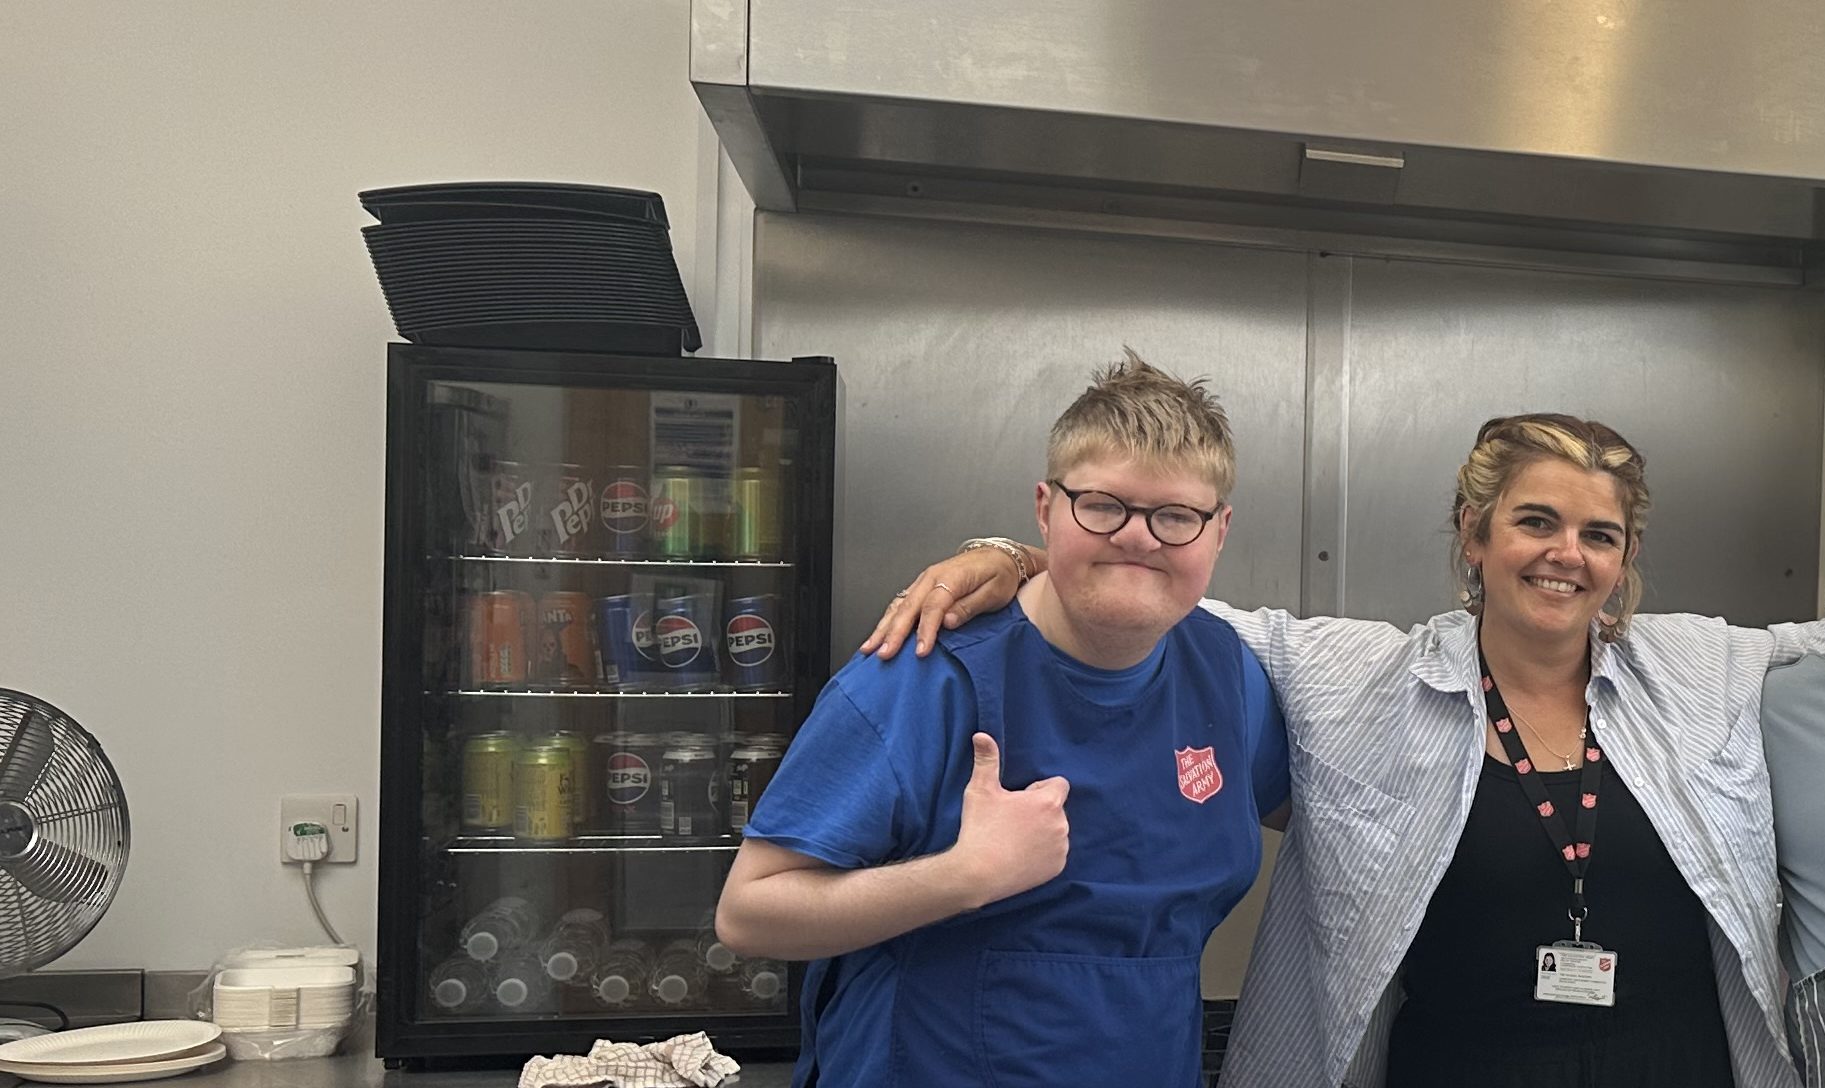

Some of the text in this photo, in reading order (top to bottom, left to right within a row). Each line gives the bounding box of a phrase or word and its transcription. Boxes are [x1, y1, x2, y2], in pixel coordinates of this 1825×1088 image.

[602, 501, 648, 514] PEPSI
[729, 633, 772, 647] PEPSI
[1181, 754, 1194, 770] THE
[1180, 755, 1214, 789] SALVATION
[1193, 770, 1215, 797] ARMY
